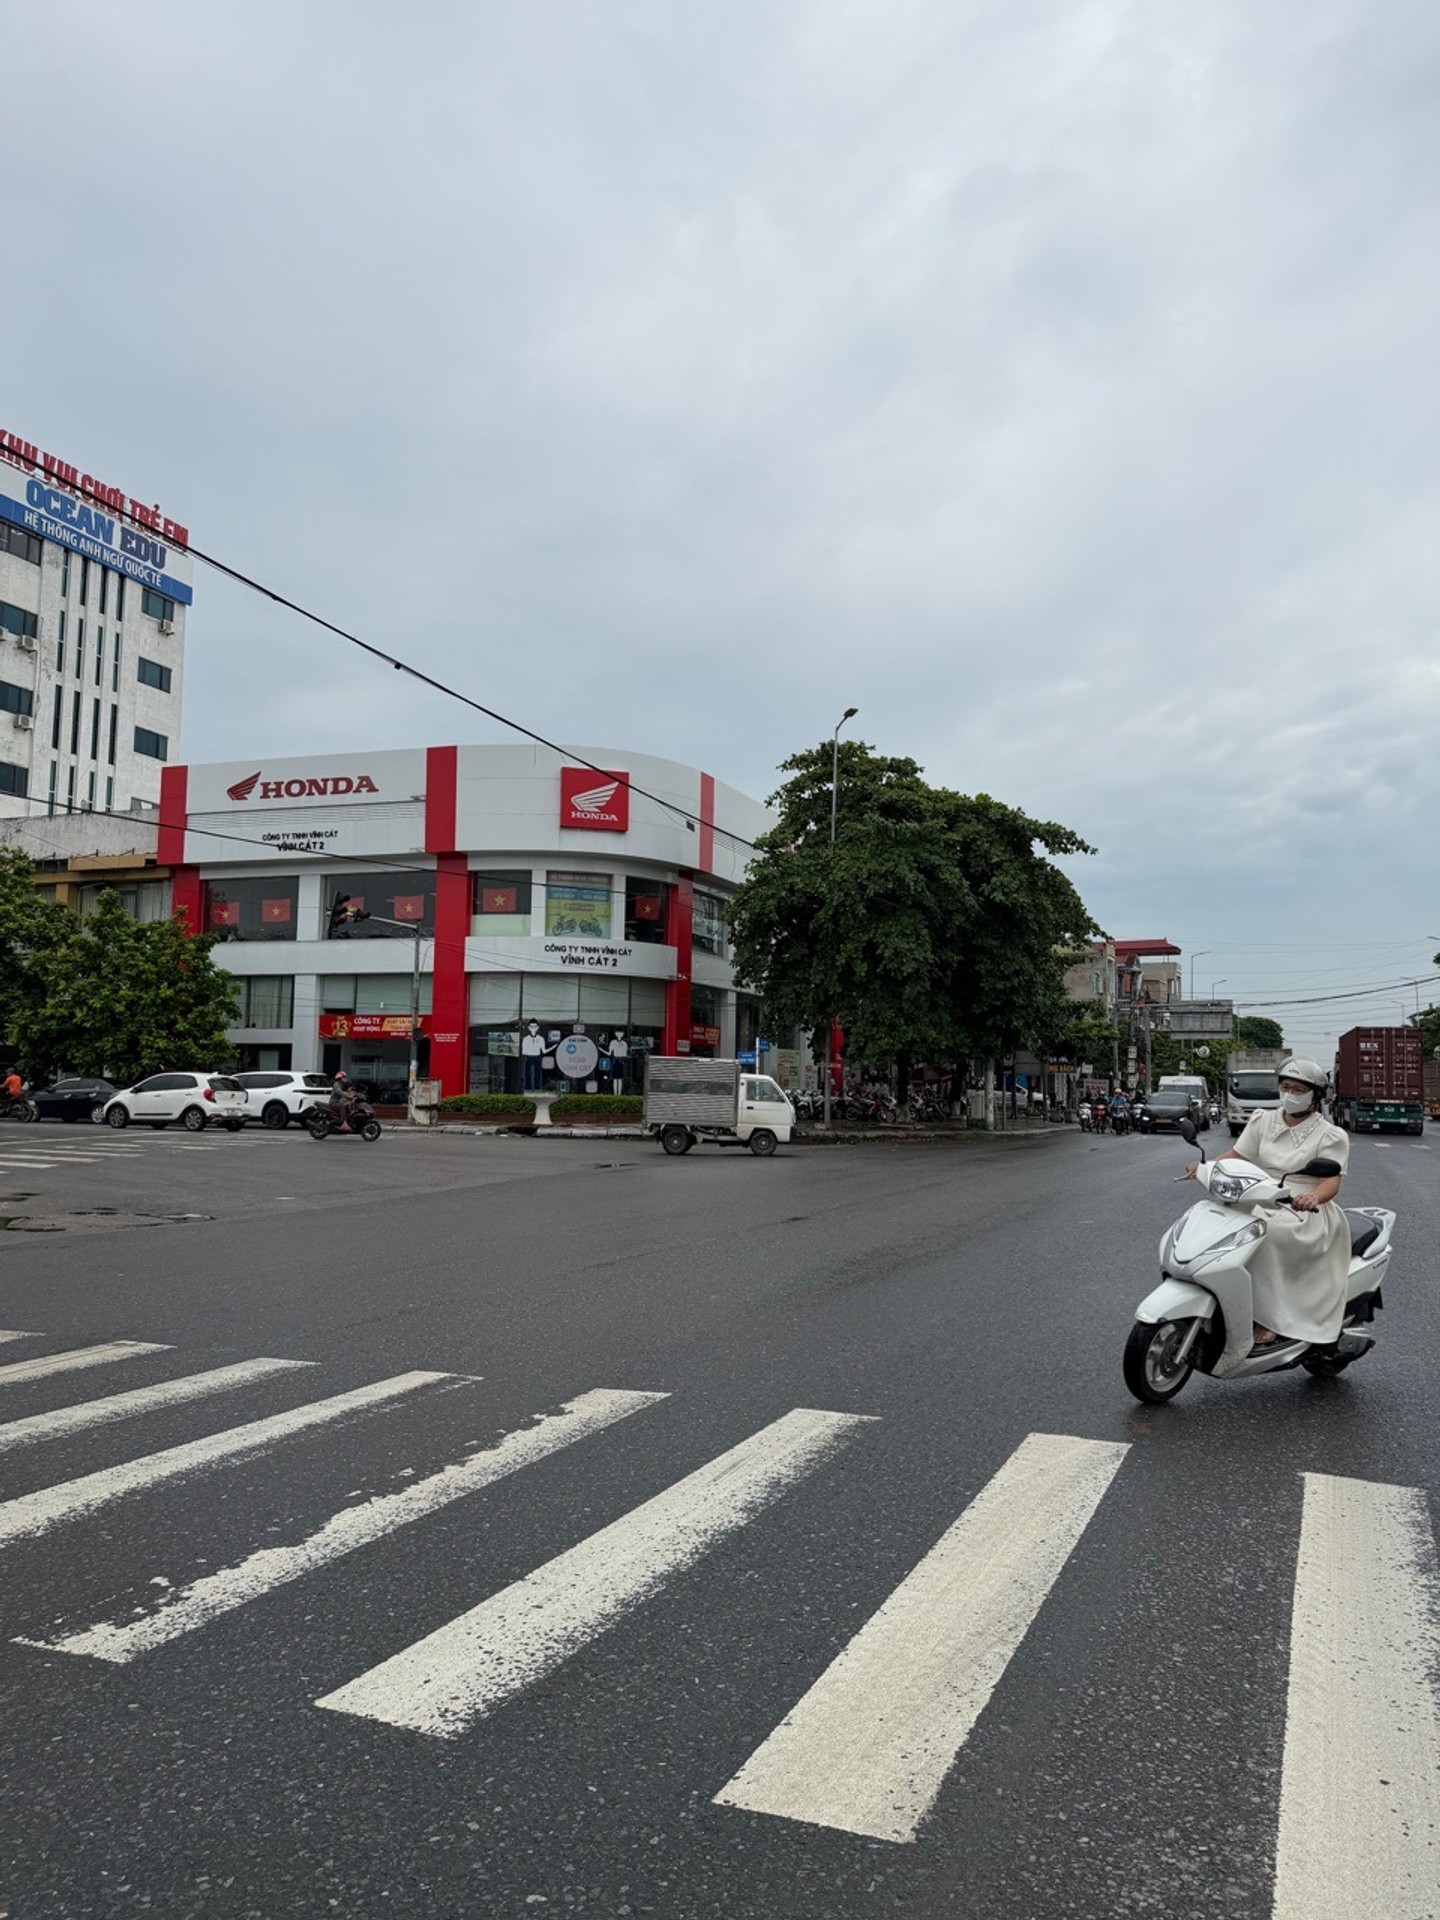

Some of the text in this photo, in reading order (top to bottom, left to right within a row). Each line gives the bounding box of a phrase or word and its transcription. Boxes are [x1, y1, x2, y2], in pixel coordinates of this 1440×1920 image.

[43, 451, 78, 494] VUI
[163, 515, 189, 549] EM
[26, 479, 168, 570] OCEAN EDU
[24, 511, 162, 587] HỆ THỐNG ANH NGỮ QUỐC TẾ
[260, 776, 380, 799] HONDA
[571, 811, 619, 822] HONDA
[262, 831, 280, 841] CÔNG
[282, 832, 291, 840] TY
[292, 832, 309, 840] TNHH
[324, 829, 338, 838] CÁT
[299, 839, 319, 850] CÁT
[320, 841, 325, 850] 2
[544, 943, 566, 953] CÔNG
[581, 946, 599, 954] TNHH
[618, 947, 632, 956] CÁT
[561, 953, 618, 967] VĨNH CÁT 2
[335, 1019, 348, 1032] 13
[353, 1016, 371, 1025] CÔNG
[372, 1017, 381, 1025] TY
